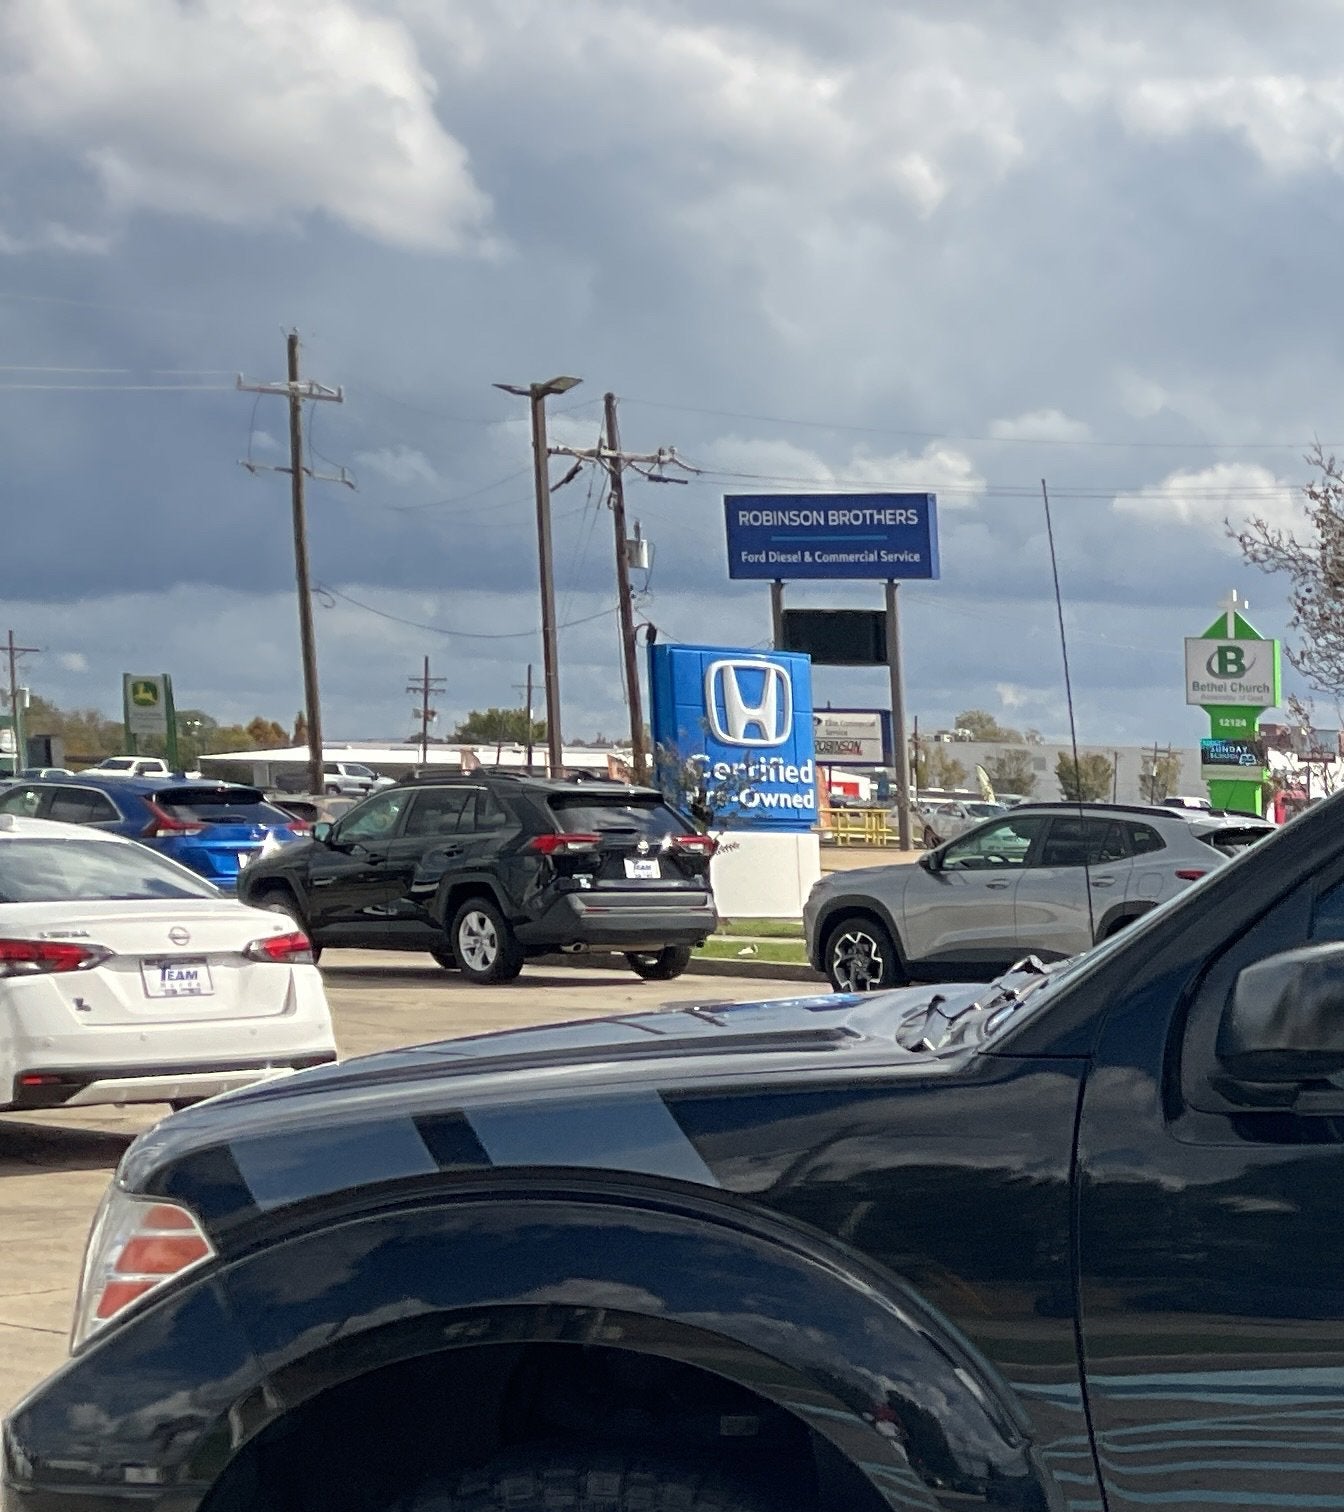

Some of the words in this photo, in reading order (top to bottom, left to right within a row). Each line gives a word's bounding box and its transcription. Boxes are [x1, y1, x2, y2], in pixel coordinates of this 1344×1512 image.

[738, 510, 824, 526] ROBINSON
[828, 509, 919, 526] BROTHERS
[741, 551, 766, 563] Ford
[769, 551, 801, 563] Diesel
[804, 552, 813, 563] &
[815, 551, 878, 563] Commercial
[880, 551, 921, 562] Service
[1192, 681, 1227, 693] Bethel
[1230, 682, 1270, 694] Church
